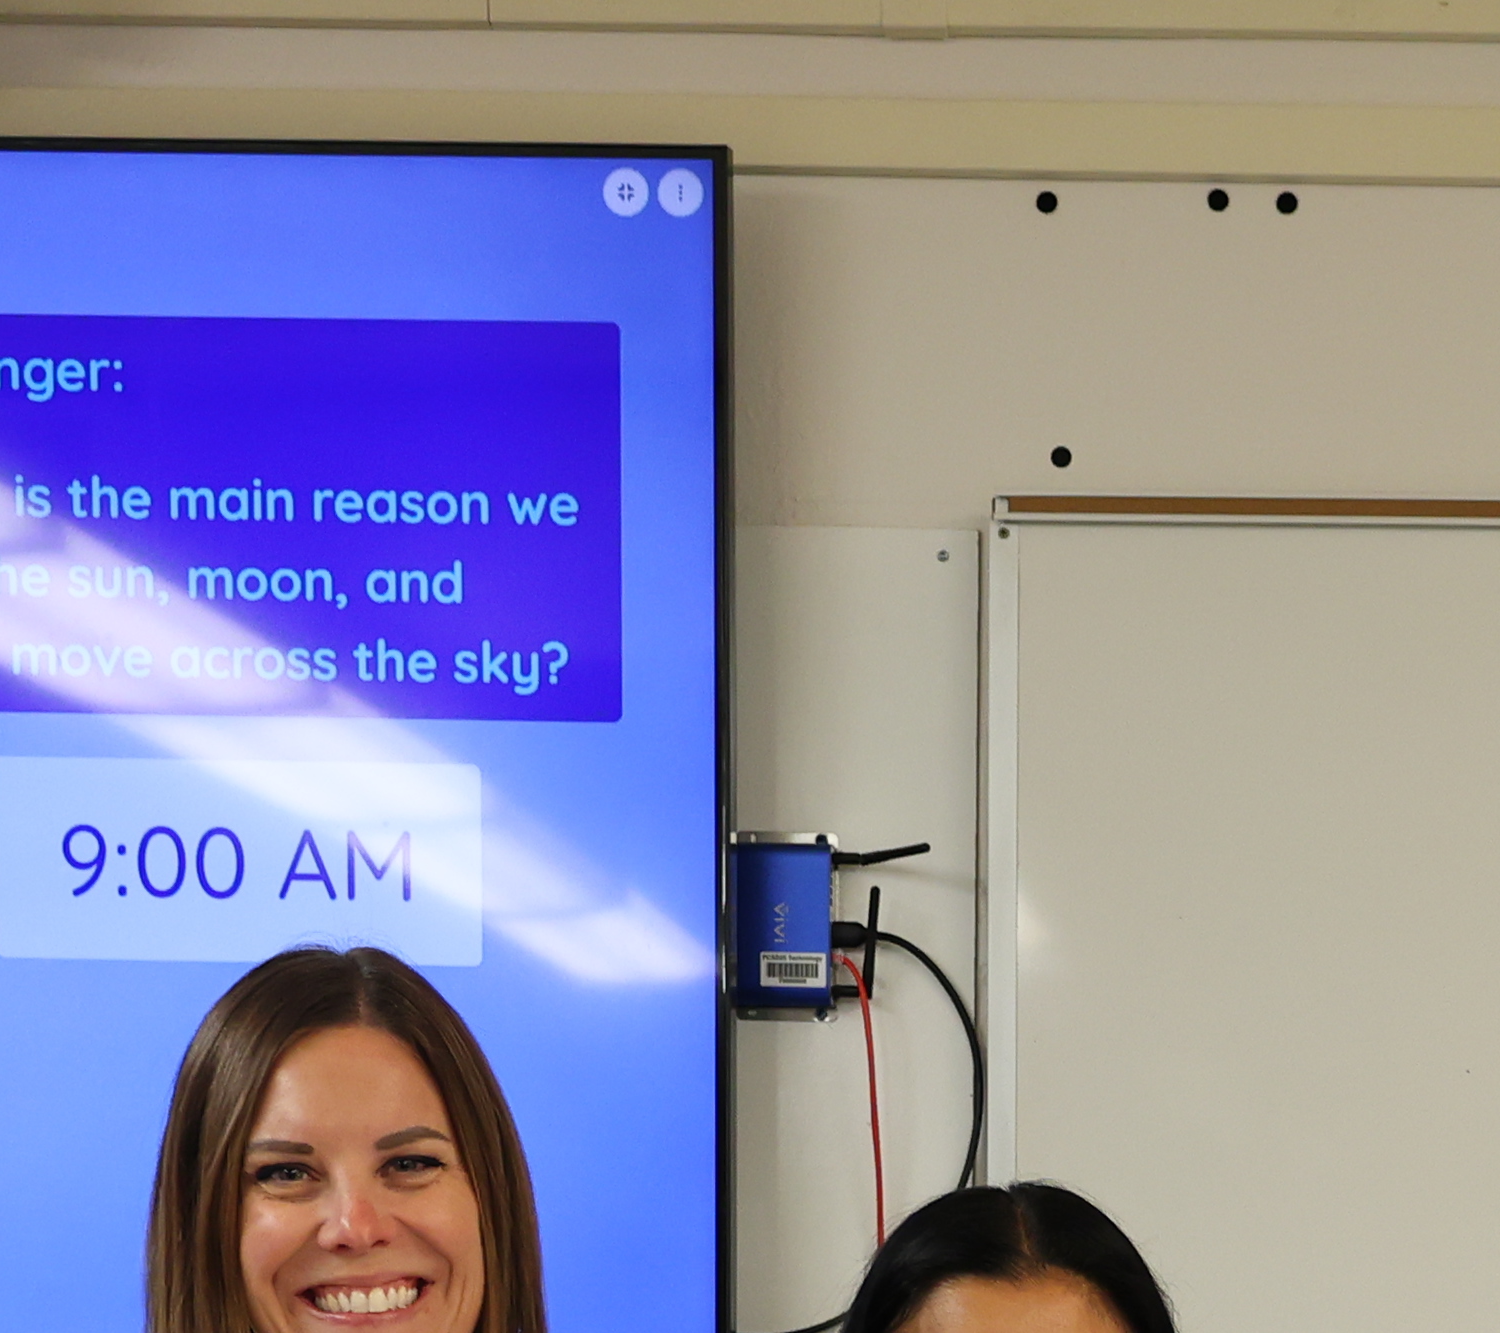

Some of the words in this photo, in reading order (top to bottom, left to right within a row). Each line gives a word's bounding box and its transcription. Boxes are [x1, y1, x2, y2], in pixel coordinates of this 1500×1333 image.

[14, 473, 52, 518] is
[66, 474, 152, 520] the
[169, 478, 296, 521] main
[312, 487, 491, 526] reason
[506, 490, 580, 527] we
[67, 562, 169, 606] sun,
[186, 565, 349, 611] moon,
[365, 558, 464, 604] and
[11, 642, 154, 678] move
[169, 645, 338, 683] across
[352, 636, 437, 684] the
[453, 638, 570, 696] sky?
[61, 823, 245, 900] 9:00
[278, 828, 411, 902] AM
